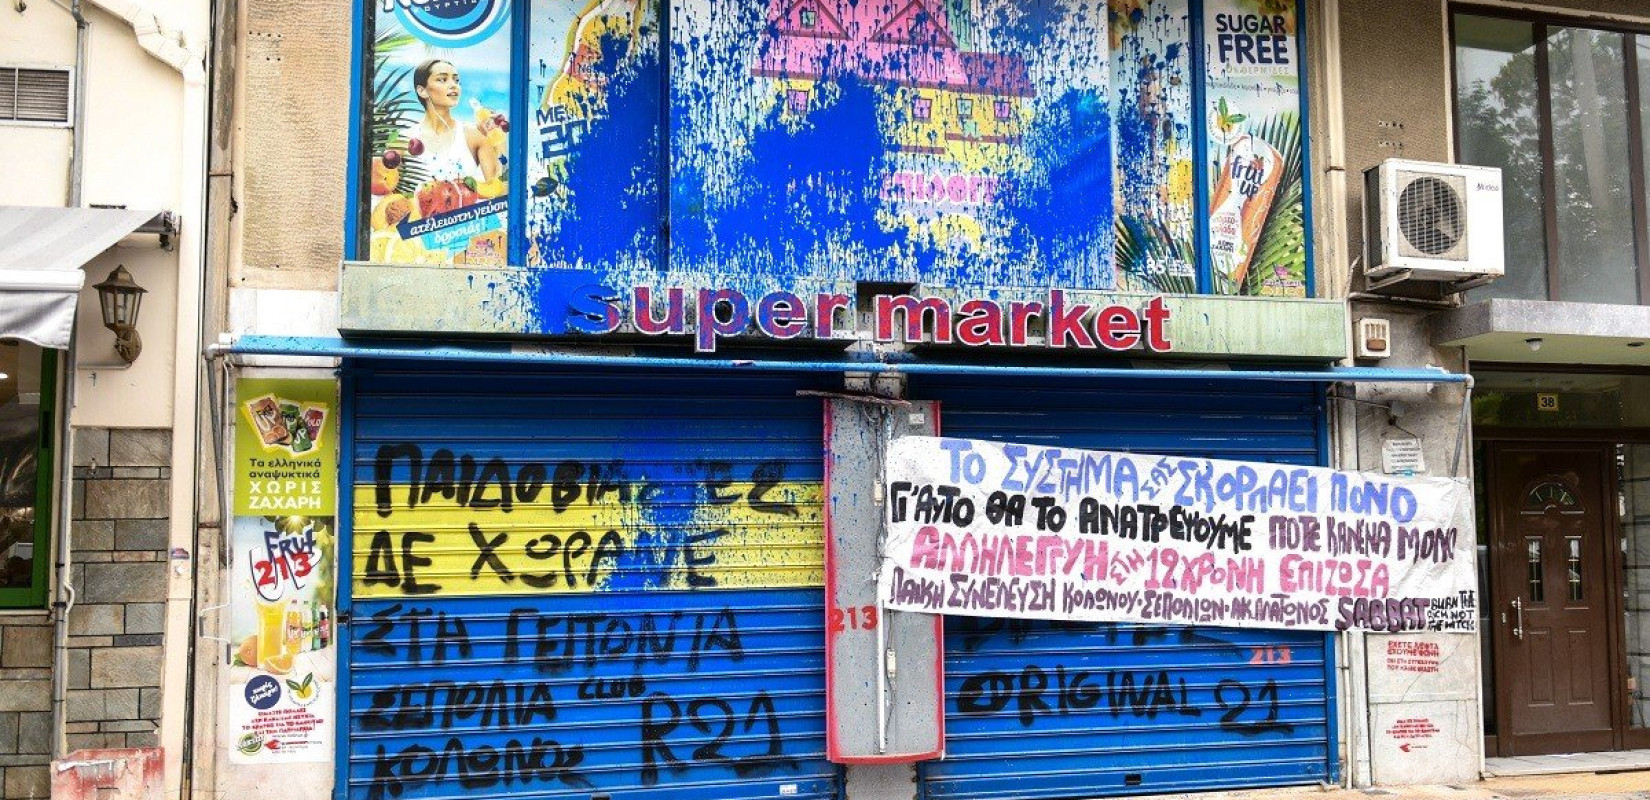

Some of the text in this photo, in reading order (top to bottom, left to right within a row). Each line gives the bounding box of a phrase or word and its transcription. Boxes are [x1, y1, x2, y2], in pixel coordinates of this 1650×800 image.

[1216, 13, 1287, 34] SUGAR
[1217, 34, 1289, 64] FREE
[565, 285, 1173, 353] super market
[1540, 397, 1555, 408] 38
[249, 458, 322, 470] Τα ελληνικά
[249, 469, 321, 481] αναψυκτικά
[249, 481, 321, 494] ΧΩΡΙΣ
[375, 444, 799, 518] ΠΑΙΔΟΒΙΑΕΣ
[1001, 443, 1139, 503] ΣΥΣΤΗΜΑ
[1141, 455, 1178, 500] ΣΑΣ
[1174, 459, 1317, 514] ΣΚΟΡΠΑΕΙ
[1330, 472, 1418, 524] ΠΟΝΟ
[248, 496, 321, 509] ΖΑΧΑΡΗ
[985, 490, 1027, 527] ΘΑ
[1030, 496, 1067, 532] ΤΟ
[1079, 497, 1255, 554] ΑΝΑΤΡΕΨΟΥΜΕ
[1326, 515, 1391, 559] ΚΑΝΕΝΑ
[254, 553, 312, 586] 213
[364, 531, 442, 594] ΔΕ
[910, 525, 1109, 581] ΑΛΛΗΛΕΓΓΥΗ
[1110, 548, 1145, 586] ΣΤΗ
[1279, 553, 1390, 598] ΕΠΙΖΩΣΑ
[947, 573, 1056, 613] ΣΥΝΕΛΕΥΣΗ
[1431, 597, 1458, 610] BURN
[829, 605, 878, 632] 213
[1335, 597, 1431, 632] SABBAT
[1450, 610, 1474, 619] NOT
[360, 604, 745, 673] ΣΤΗ ΓΕΙΤΟΝΙΑ
[1250, 646, 1292, 665] 213
[956, 664, 1200, 727] ORIGINAL
